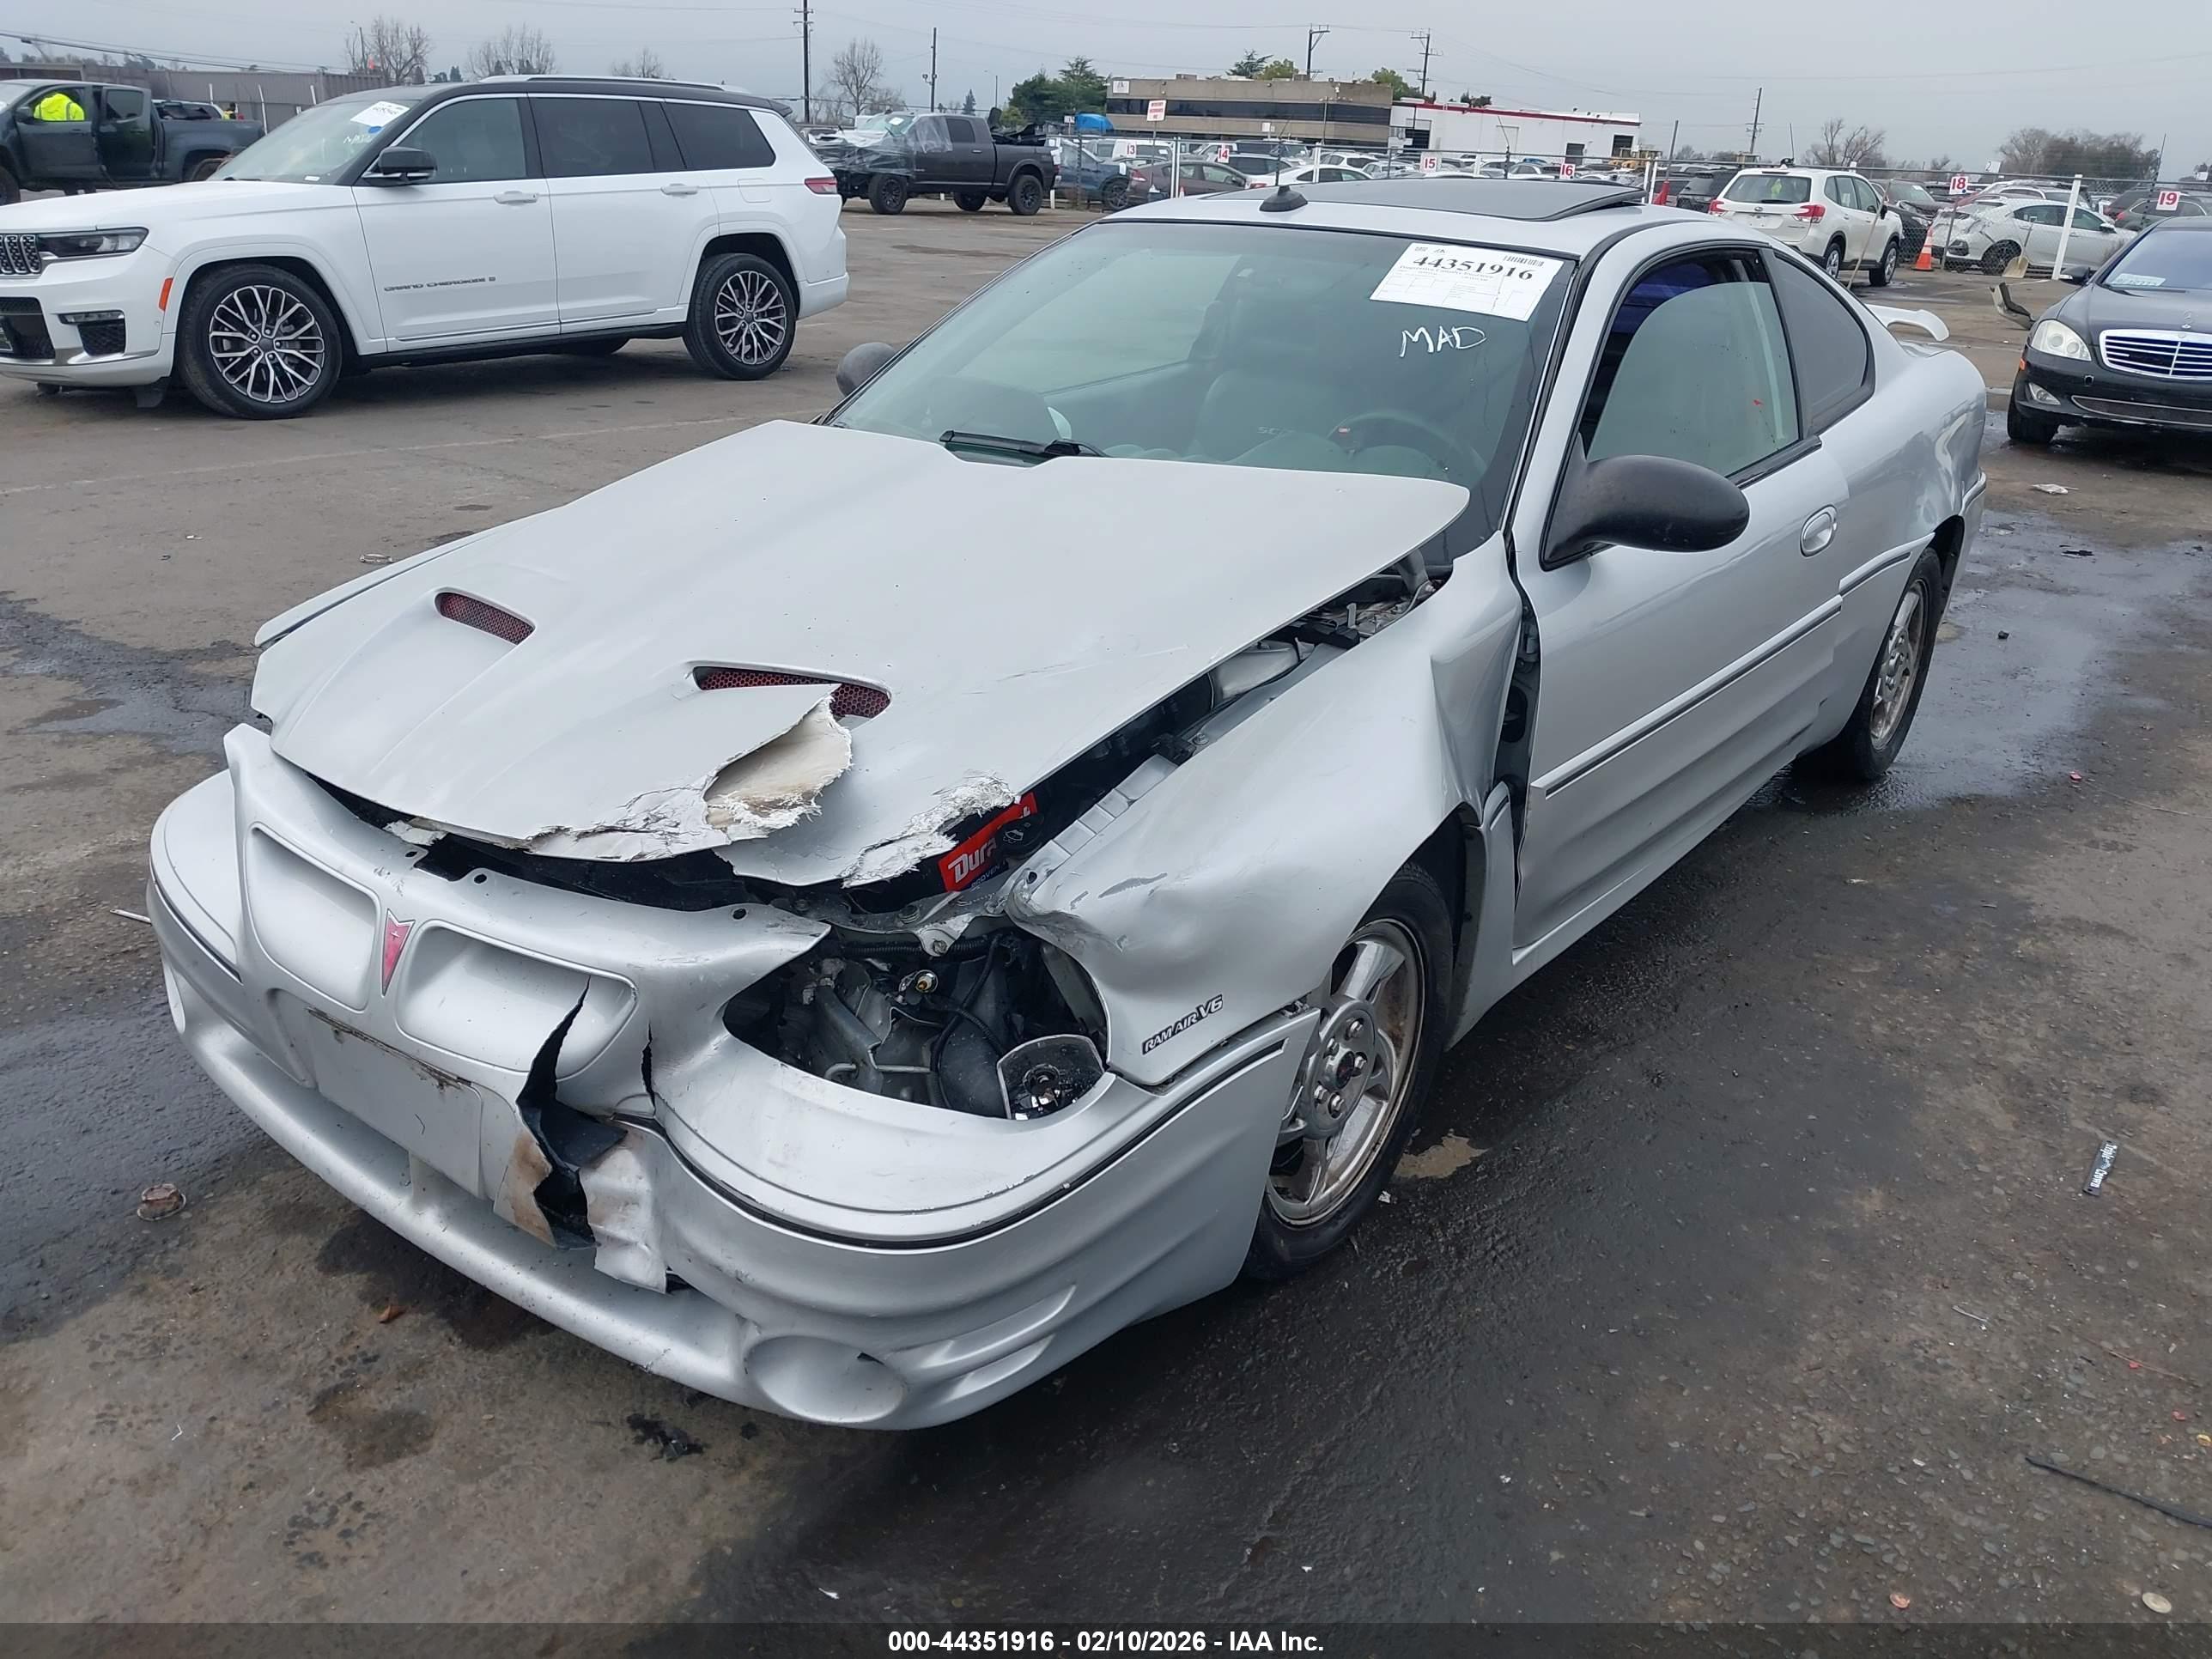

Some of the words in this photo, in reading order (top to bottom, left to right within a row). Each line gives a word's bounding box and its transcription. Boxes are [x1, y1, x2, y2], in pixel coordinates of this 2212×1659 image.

[1127, 143, 1135, 155] 13
[1218, 149, 1228, 159] 14
[1424, 158, 1436, 169] 15
[1561, 165, 1573, 176] 16
[1952, 178, 1966, 190] 18
[2159, 192, 2177, 205] 19
[1413, 256, 1536, 281] 44351916
[1400, 325, 1487, 357] MAD
[1144, 1026, 1173, 1054] RAM
[1175, 1012, 1198, 1035] AIR
[1199, 996, 1224, 1018] V6
[2090, 1168, 2108, 1188] Crown
